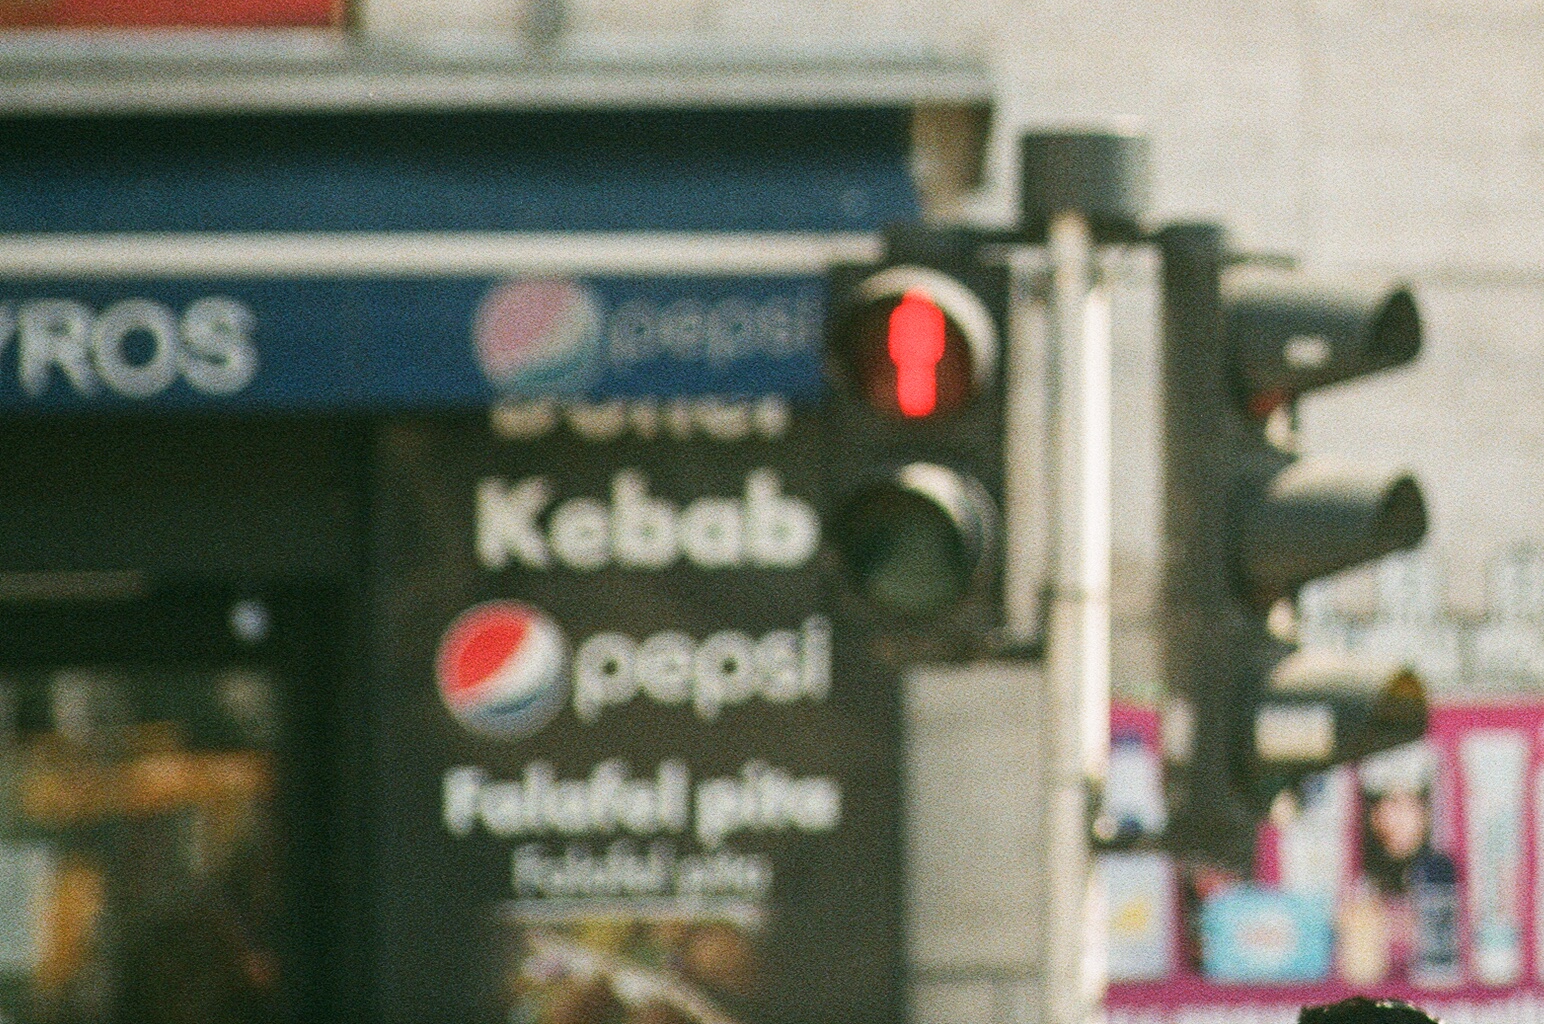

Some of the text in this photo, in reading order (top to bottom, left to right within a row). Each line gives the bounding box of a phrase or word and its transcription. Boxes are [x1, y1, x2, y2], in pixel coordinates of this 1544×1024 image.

[0, 297, 258, 396] ROS
[475, 470, 819, 571] Kebab
[573, 614, 833, 723] pepsi
[442, 760, 841, 847] Falafel pita
